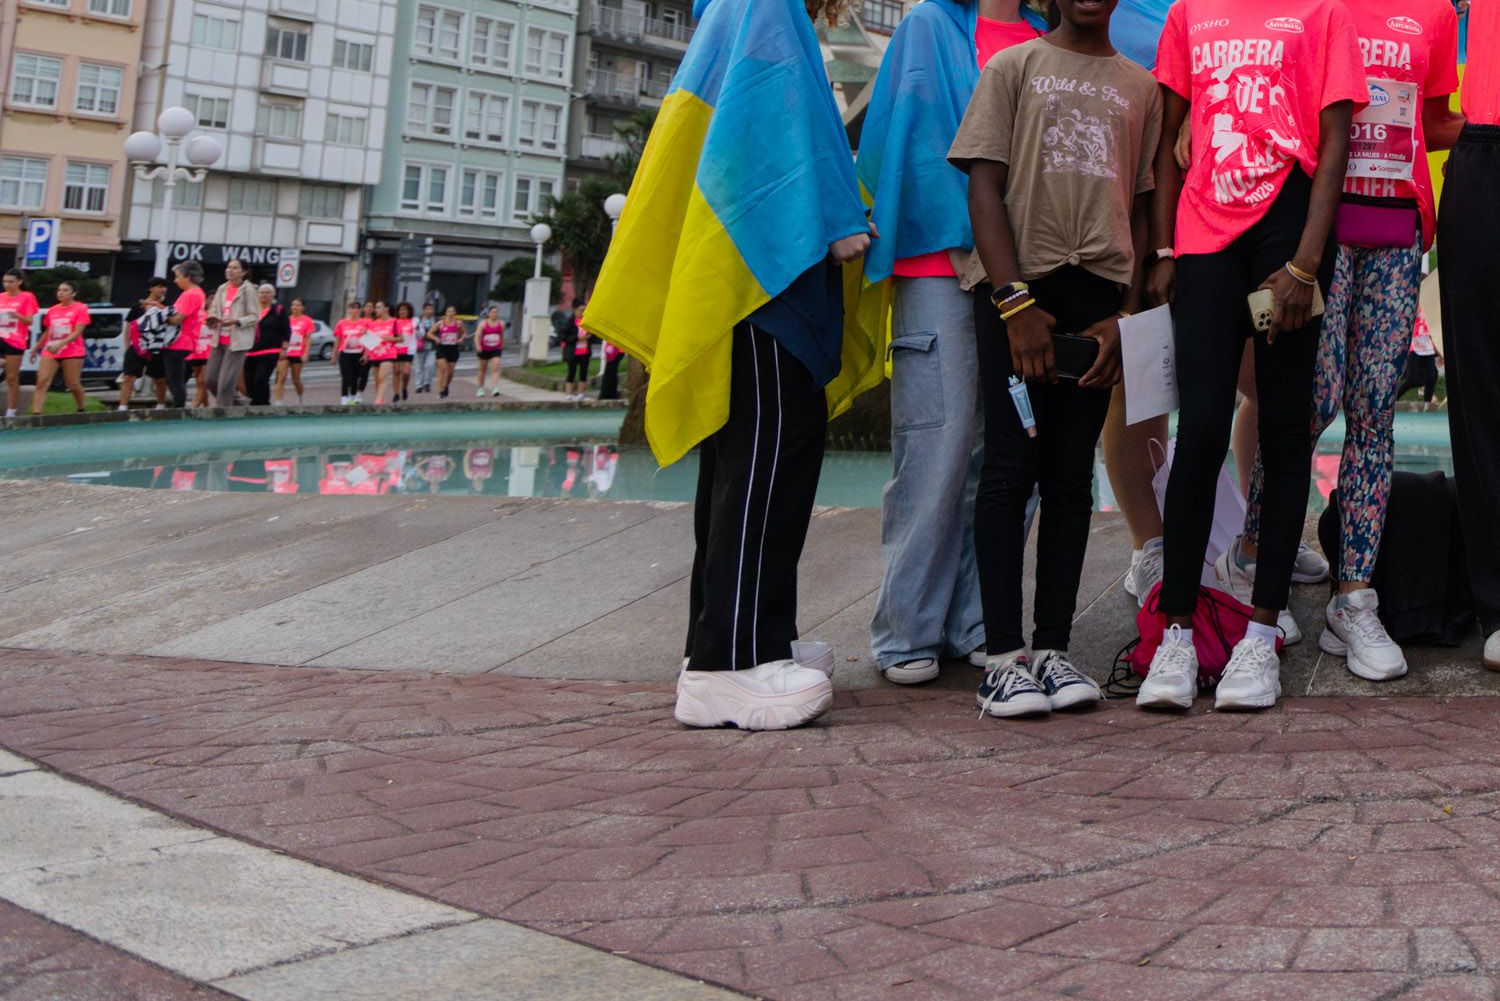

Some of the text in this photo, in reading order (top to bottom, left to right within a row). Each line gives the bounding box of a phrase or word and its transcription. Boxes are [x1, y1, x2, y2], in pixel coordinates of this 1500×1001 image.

[1190, 18, 1229, 35] OYSHO
[1191, 39, 1284, 75] CARRERA
[1358, 37, 1411, 70] RERA
[1031, 75, 1130, 110] Wild & Free
[1236, 75, 1267, 114] DE
[1245, 181, 1275, 206] 2026
[29, 220, 50, 253] P
[221, 246, 279, 264] WANG
